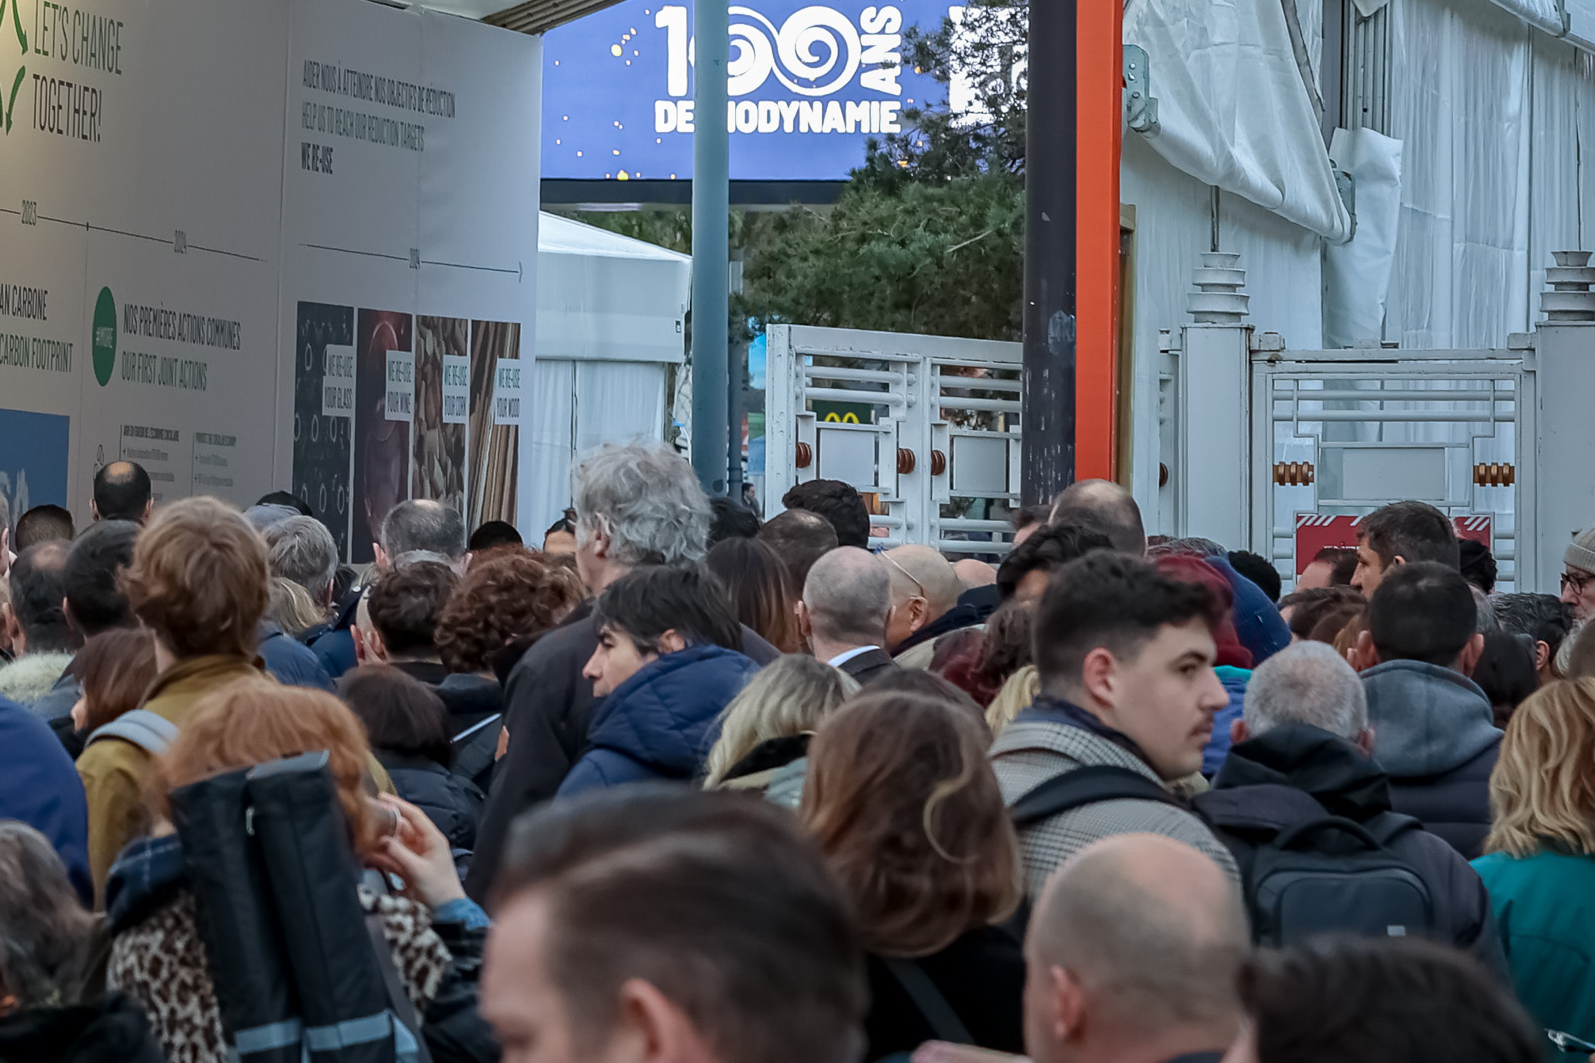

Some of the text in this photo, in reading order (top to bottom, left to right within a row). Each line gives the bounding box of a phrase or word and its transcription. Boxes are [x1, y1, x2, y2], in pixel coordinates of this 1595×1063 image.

[34, 0, 124, 76] LET'S CHANGE
[860, 5, 903, 96] ANS
[32, 73, 102, 143] TOGETHER!
[654, 100, 902, 134] DE IODYNAMIE
[21, 199, 38, 227] 2023
[11, 284, 48, 321] CARBONE
[123, 300, 241, 351] NOS PREMIÈRES ACTIONS COMMUNES
[31, 337, 74, 373] FOOTPRINT
[121, 350, 208, 391] OUR FIRST JOINT ACTIONS
